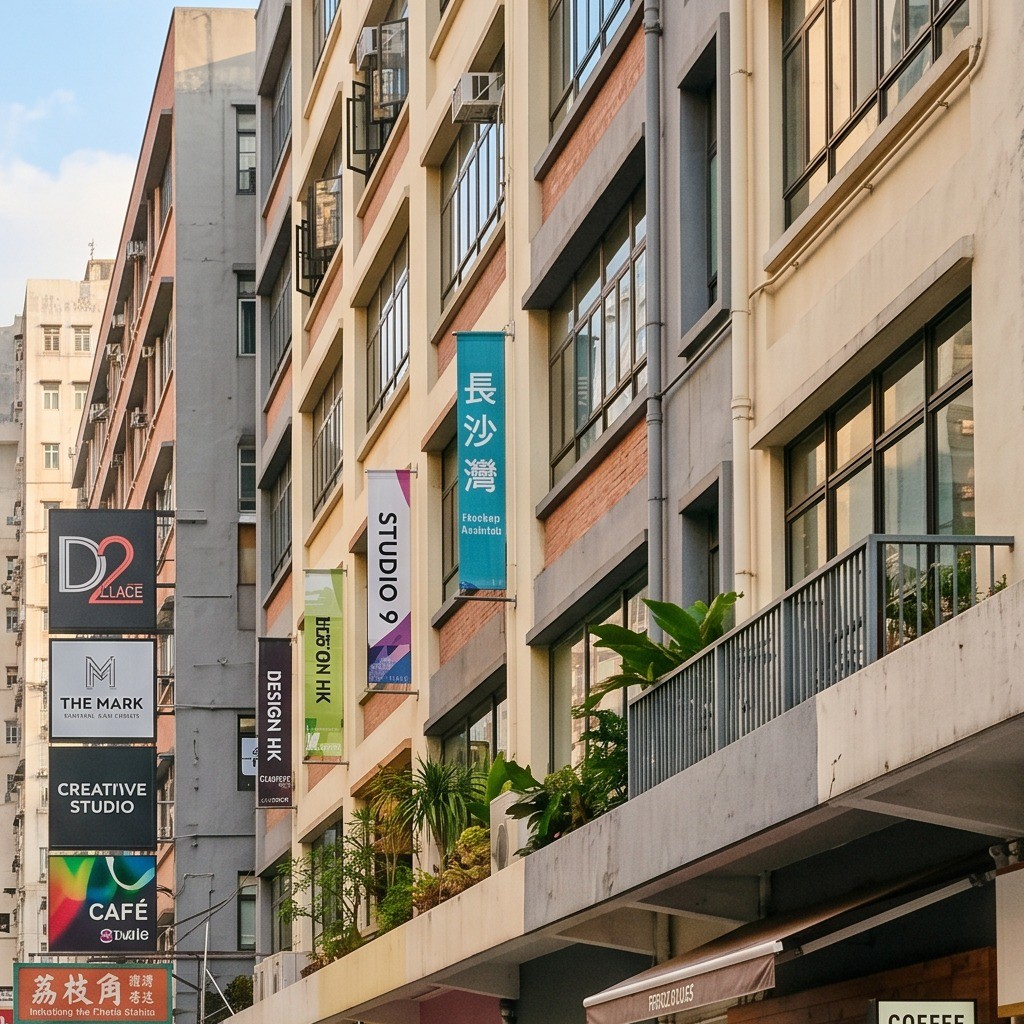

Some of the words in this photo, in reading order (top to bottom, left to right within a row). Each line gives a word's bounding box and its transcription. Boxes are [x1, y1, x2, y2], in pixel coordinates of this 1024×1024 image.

[463, 372, 497, 493] 長沙灣
[378, 512, 398, 602] STUDIO
[378, 610, 399, 624] 9
[267, 671, 282, 731] DESIGN
[315, 680, 331, 703] HK
[60, 697, 92, 710] THE
[96, 697, 143, 710] MARK
[267, 738, 282, 762] HK
[70, 800, 135, 814] STUDIO
[89, 898, 148, 921] CAFÉ
[31, 972, 121, 1006] 荔枝角
